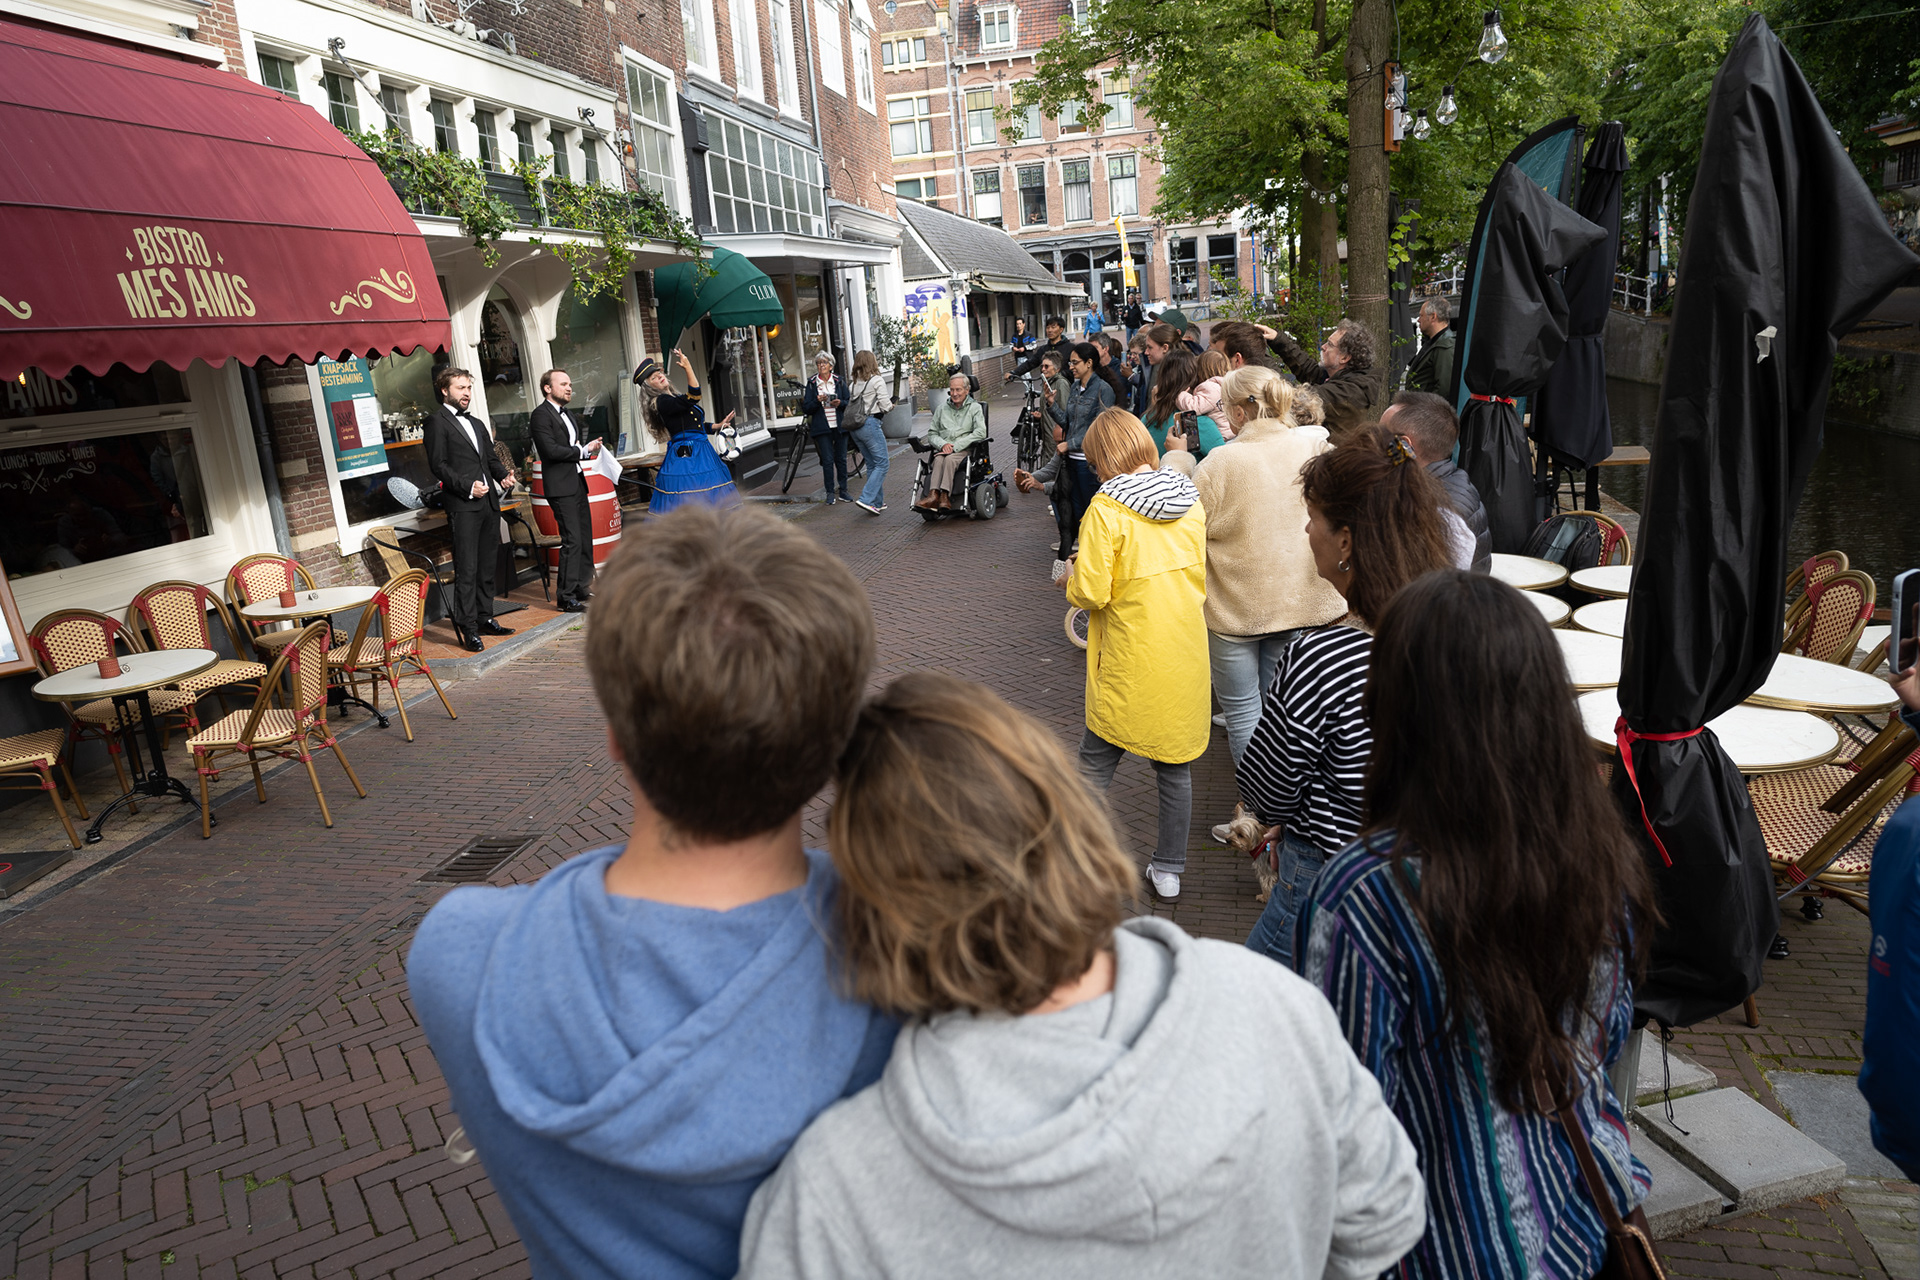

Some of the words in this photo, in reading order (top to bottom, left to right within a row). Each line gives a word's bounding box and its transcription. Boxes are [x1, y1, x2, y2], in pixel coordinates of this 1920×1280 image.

[133, 225, 212, 268] BISTRO
[117, 267, 188, 319] MES
[186, 267, 257, 318] AMIS
[321, 361, 359, 374] KNAPSACK
[6, 368, 79, 410] AMIS
[320, 372, 364, 387] BESTEMMING
[776, 390, 792, 399] olive
[792, 388, 802, 397] oil
[0, 455, 29, 470] LUNCH
[35, 449, 66, 466] DRINKS
[71, 446, 96, 461] DINER
[21, 480, 31, 490] 20
[42, 477, 51, 488] 21
